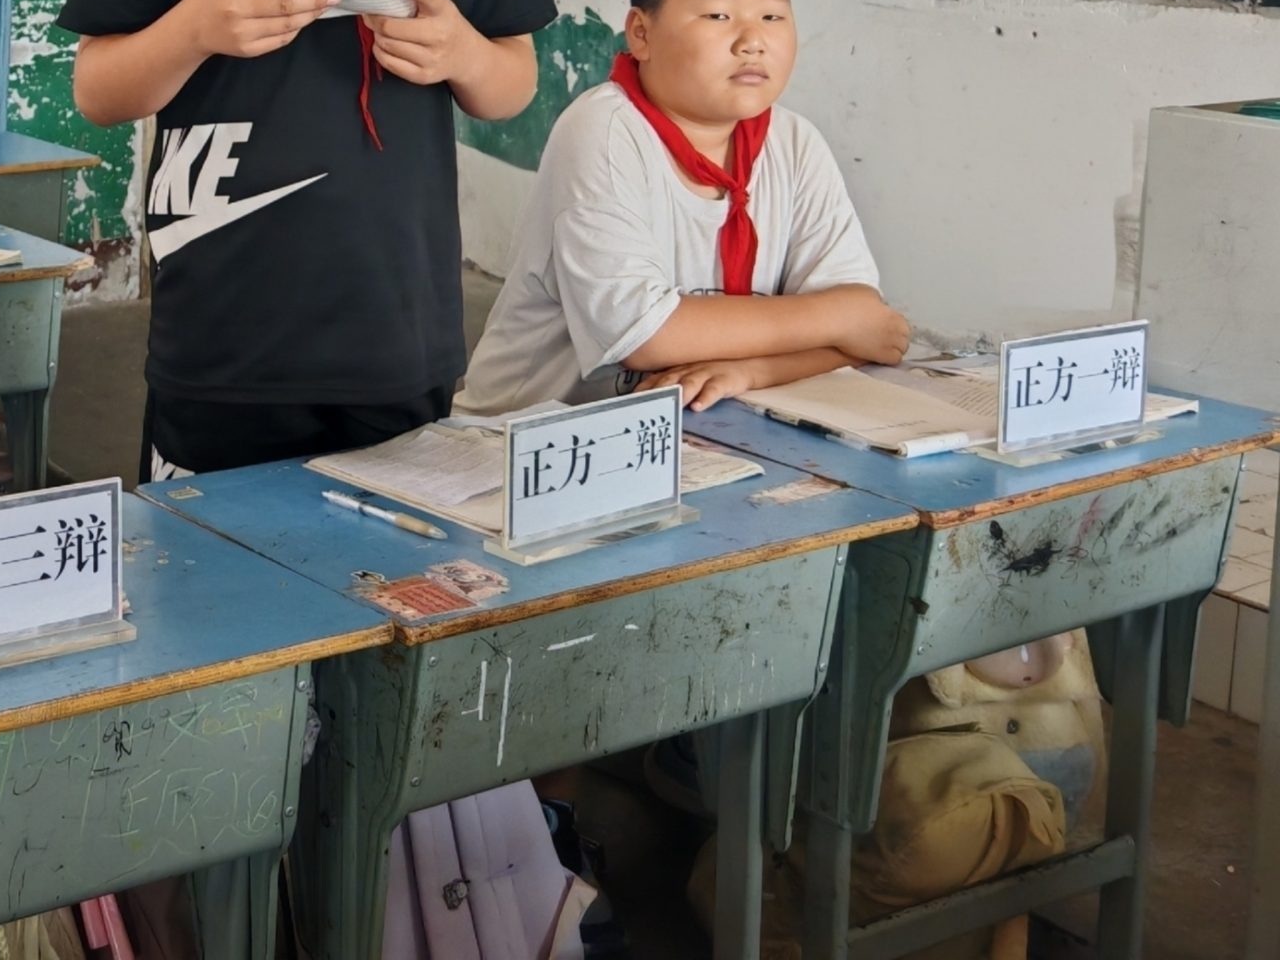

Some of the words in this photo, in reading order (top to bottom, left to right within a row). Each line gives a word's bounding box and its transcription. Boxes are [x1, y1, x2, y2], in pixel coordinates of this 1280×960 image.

[1010, 346, 1142, 410] 正方一辩
[516, 415, 673, 501] 正方二辩
